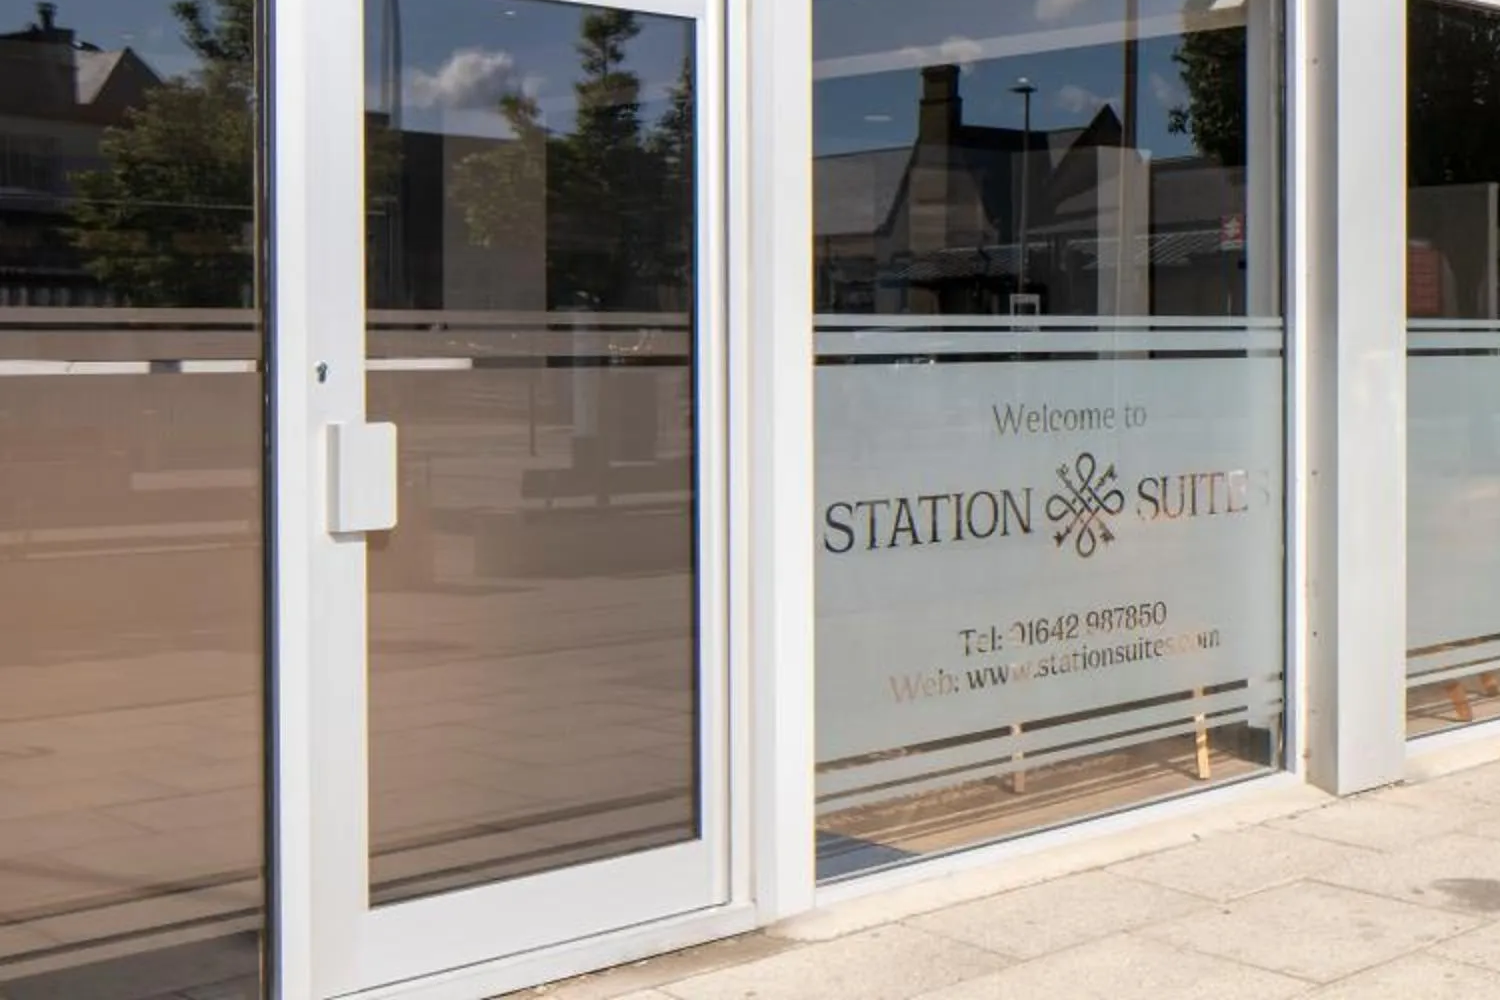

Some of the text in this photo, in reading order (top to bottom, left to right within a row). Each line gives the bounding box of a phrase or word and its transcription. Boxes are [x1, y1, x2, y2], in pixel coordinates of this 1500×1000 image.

[991, 404, 1148, 436] Welcome to
[823, 487, 1033, 554] STATION
[959, 601, 1168, 657] Tel: 01642 987850
